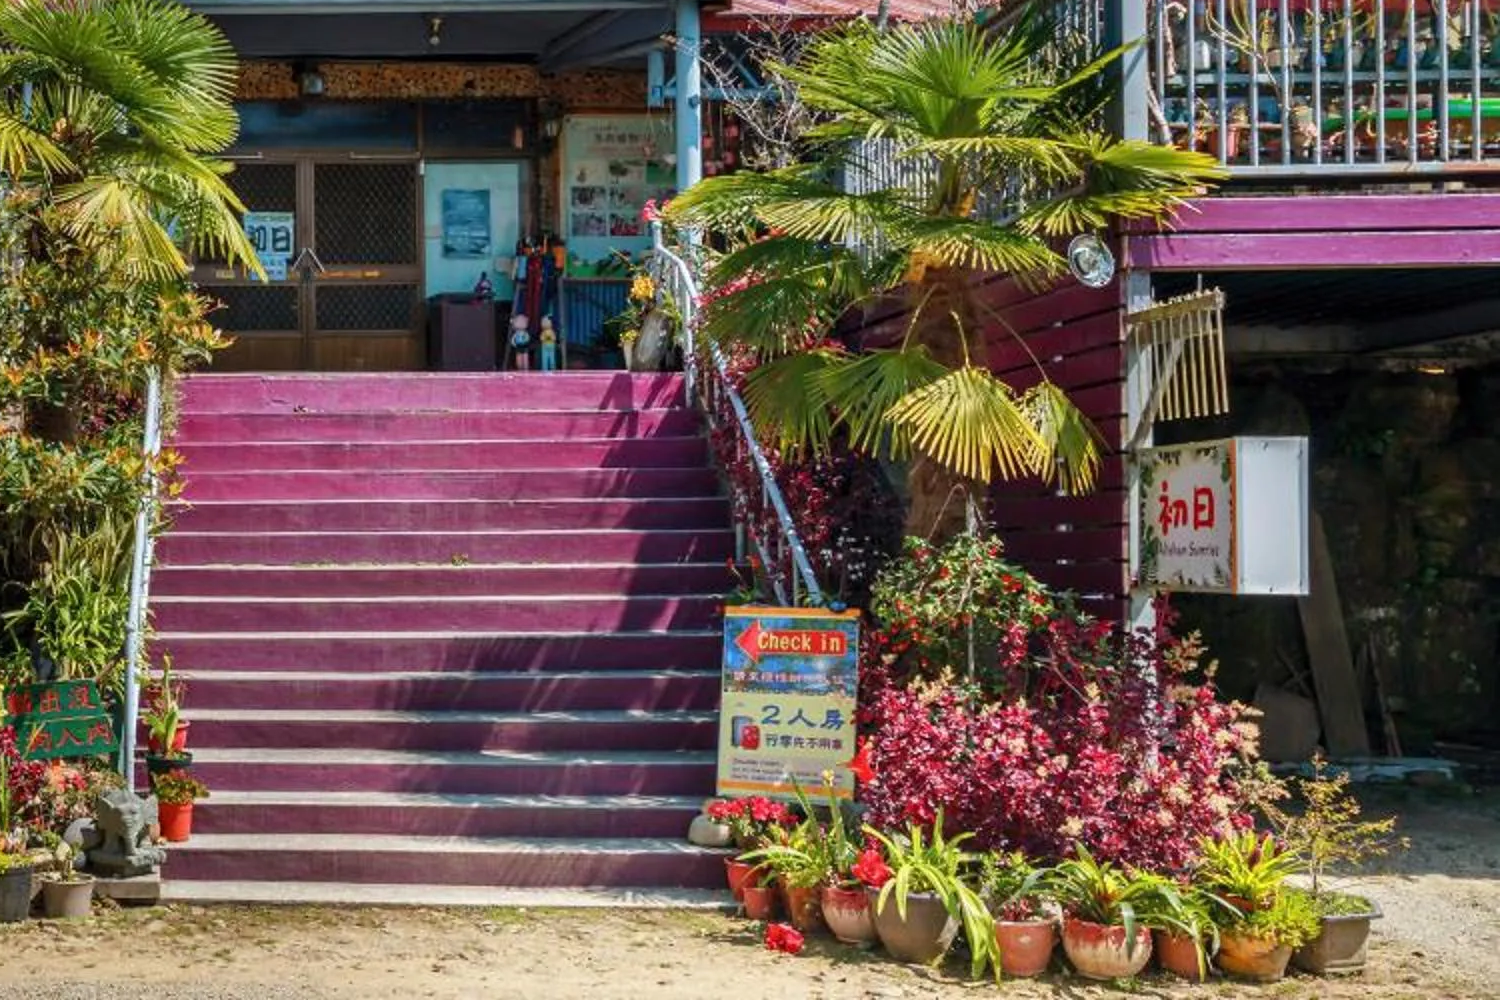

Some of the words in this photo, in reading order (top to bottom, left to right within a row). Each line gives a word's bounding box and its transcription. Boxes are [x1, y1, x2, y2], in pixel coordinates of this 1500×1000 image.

[1158, 480, 1215, 536] 初日
[757, 631, 811, 650] Check
[821, 633, 841, 652] in
[761, 705, 845, 730] 2人房
